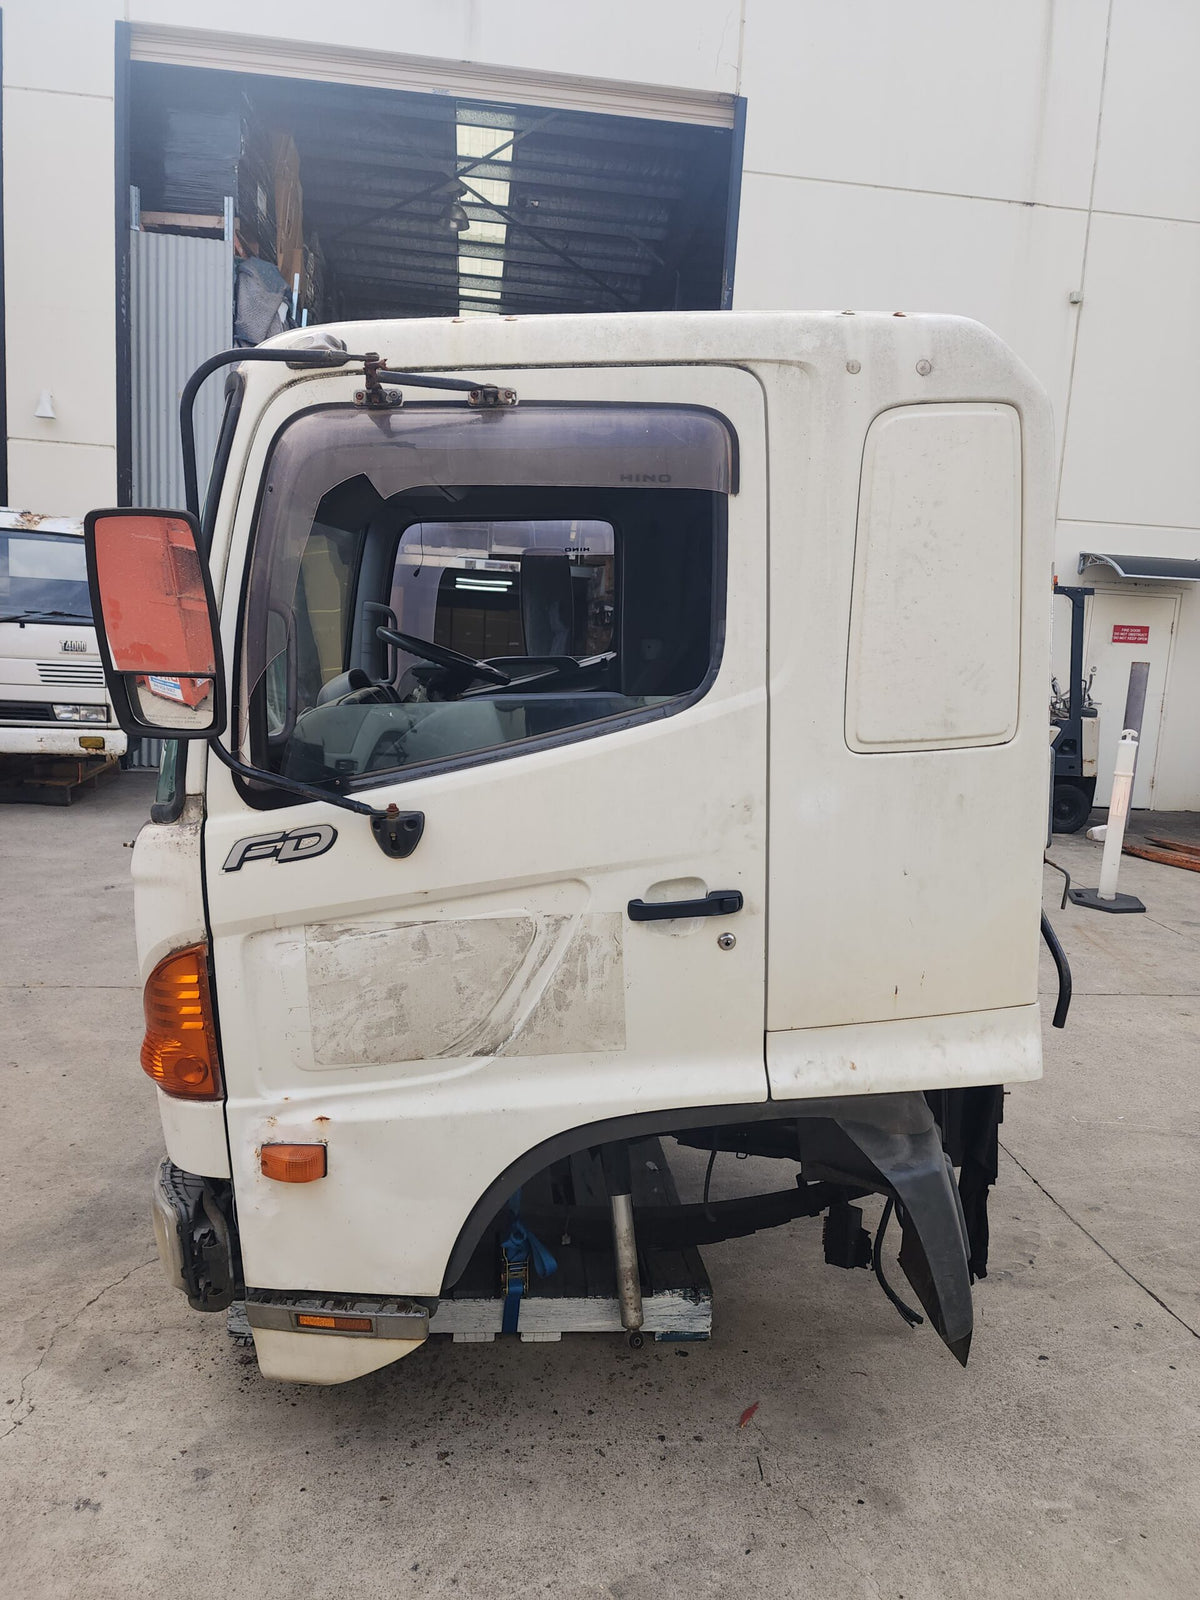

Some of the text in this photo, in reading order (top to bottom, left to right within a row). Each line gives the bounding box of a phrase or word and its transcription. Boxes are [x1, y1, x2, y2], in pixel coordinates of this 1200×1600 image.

[620, 474, 672, 483] HINO
[59, 640, 87, 653] T4000
[222, 824, 338, 872] FD
